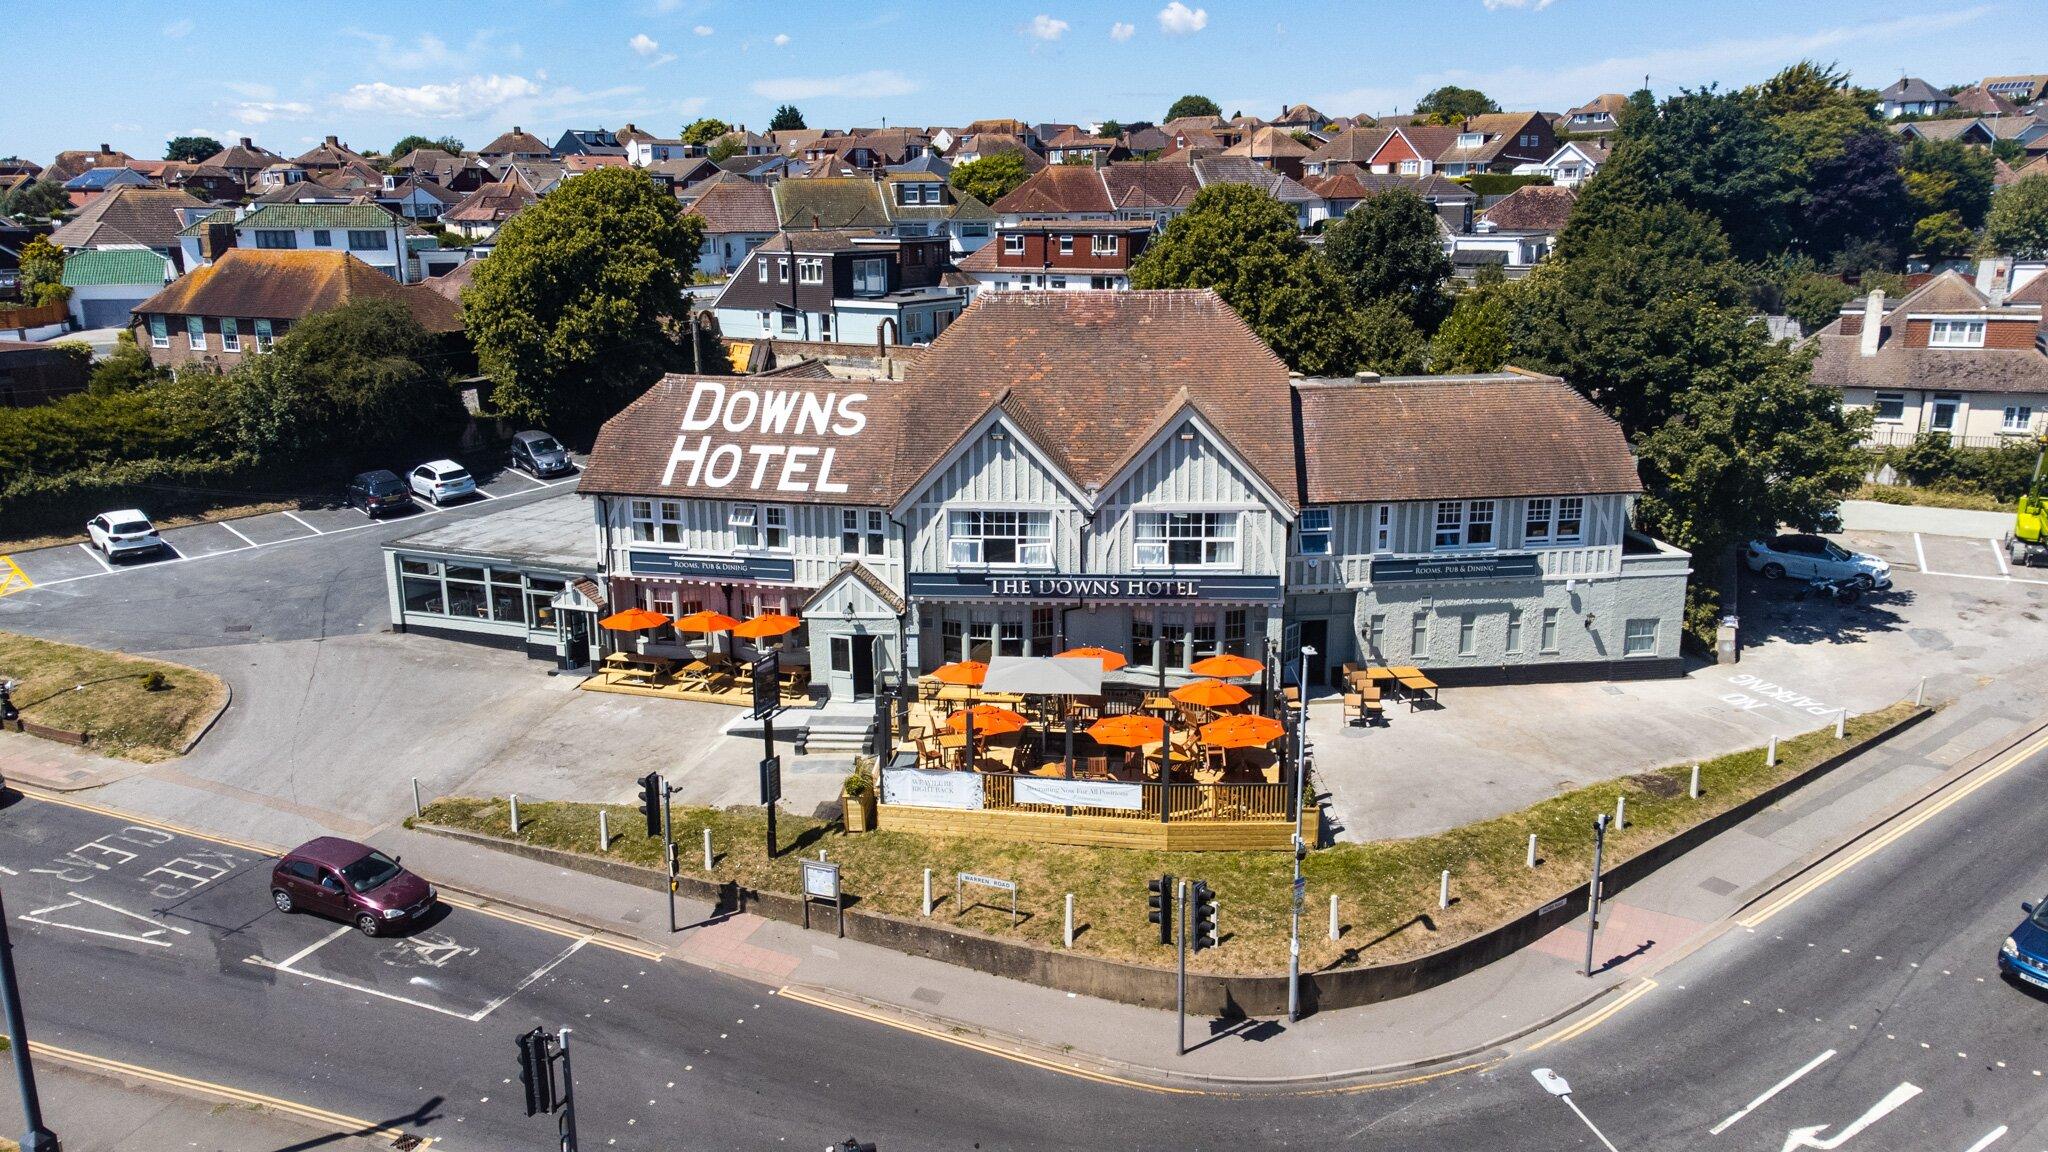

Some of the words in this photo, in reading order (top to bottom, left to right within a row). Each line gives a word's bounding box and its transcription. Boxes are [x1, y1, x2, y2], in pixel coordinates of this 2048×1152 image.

[681, 382, 868, 436] DOWNS
[661, 435, 849, 493] HOTEL
[1467, 564, 1494, 573] DINING
[991, 580, 1031, 594] THE
[1039, 580, 1120, 595] DOWNS
[1127, 580, 1198, 595] HOTEL
[1720, 693, 1769, 710] NO
[1727, 674, 1840, 715] PARKING
[1061, 786, 1075, 794] Now
[29, 825, 175, 883] CLEAR
[138, 848, 250, 899] KEEP
[964, 875, 990, 884] WARREN
